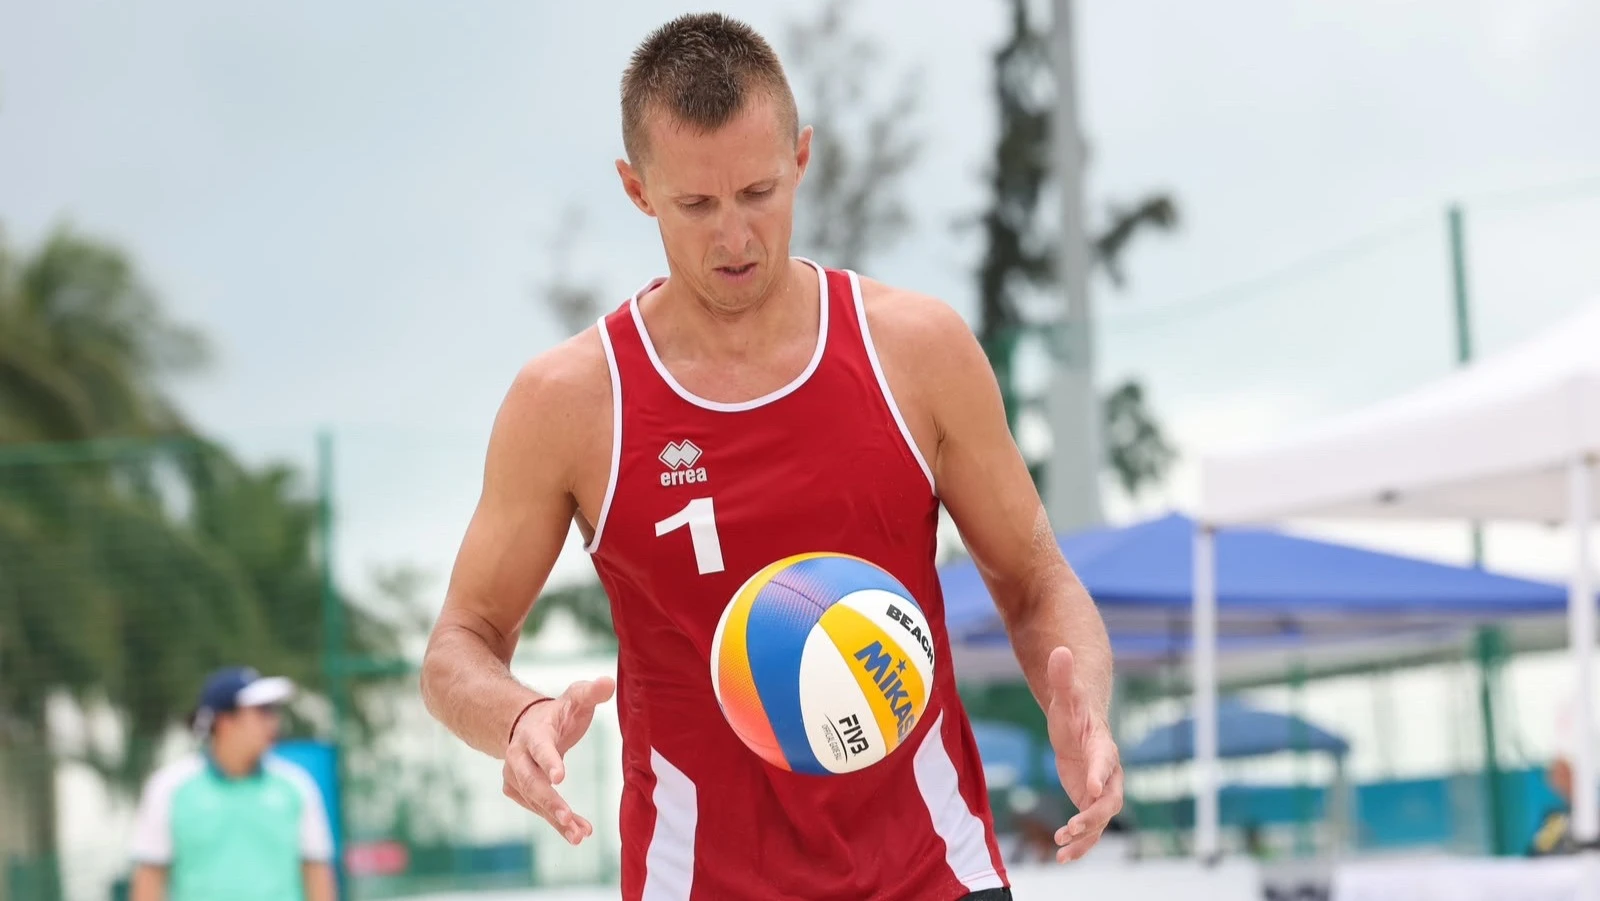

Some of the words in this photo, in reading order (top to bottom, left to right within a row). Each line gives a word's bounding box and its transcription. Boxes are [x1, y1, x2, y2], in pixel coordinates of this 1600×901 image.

[660, 467, 708, 486] errea
[655, 497, 725, 575] 1
[886, 604, 934, 665] BEACH
[854, 641, 914, 743] MIKAS
